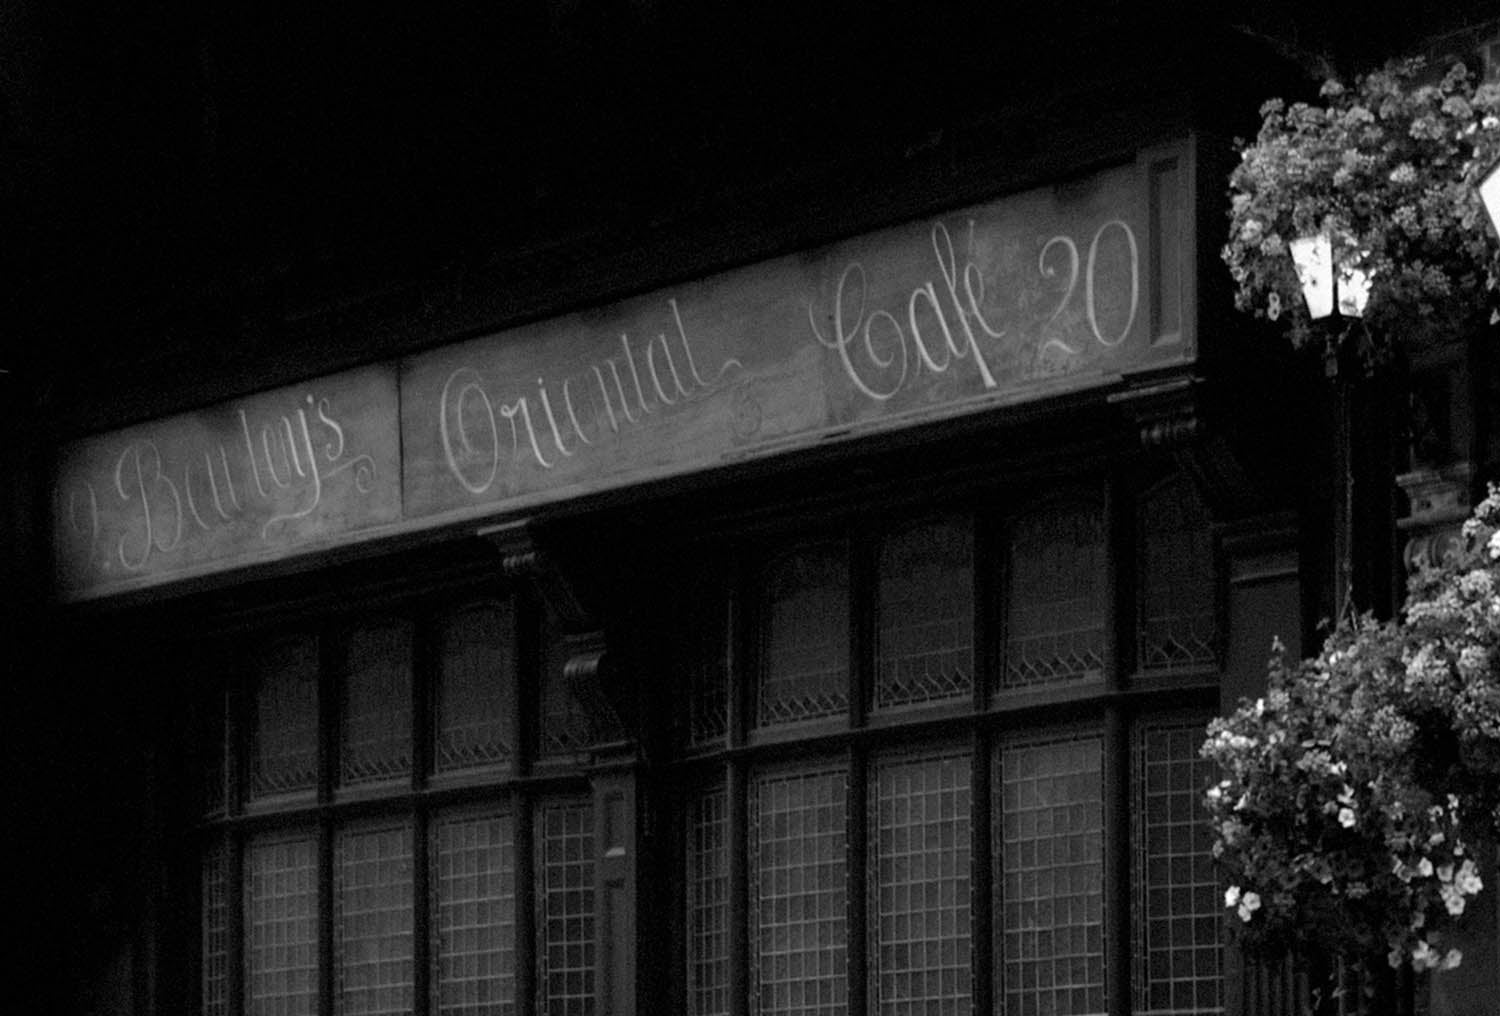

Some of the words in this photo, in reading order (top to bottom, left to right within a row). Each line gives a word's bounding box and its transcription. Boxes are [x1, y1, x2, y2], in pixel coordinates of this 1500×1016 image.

[440, 299, 708, 495] Oriental
[808, 219, 1007, 401] Café
[1037, 219, 1140, 362] 20
